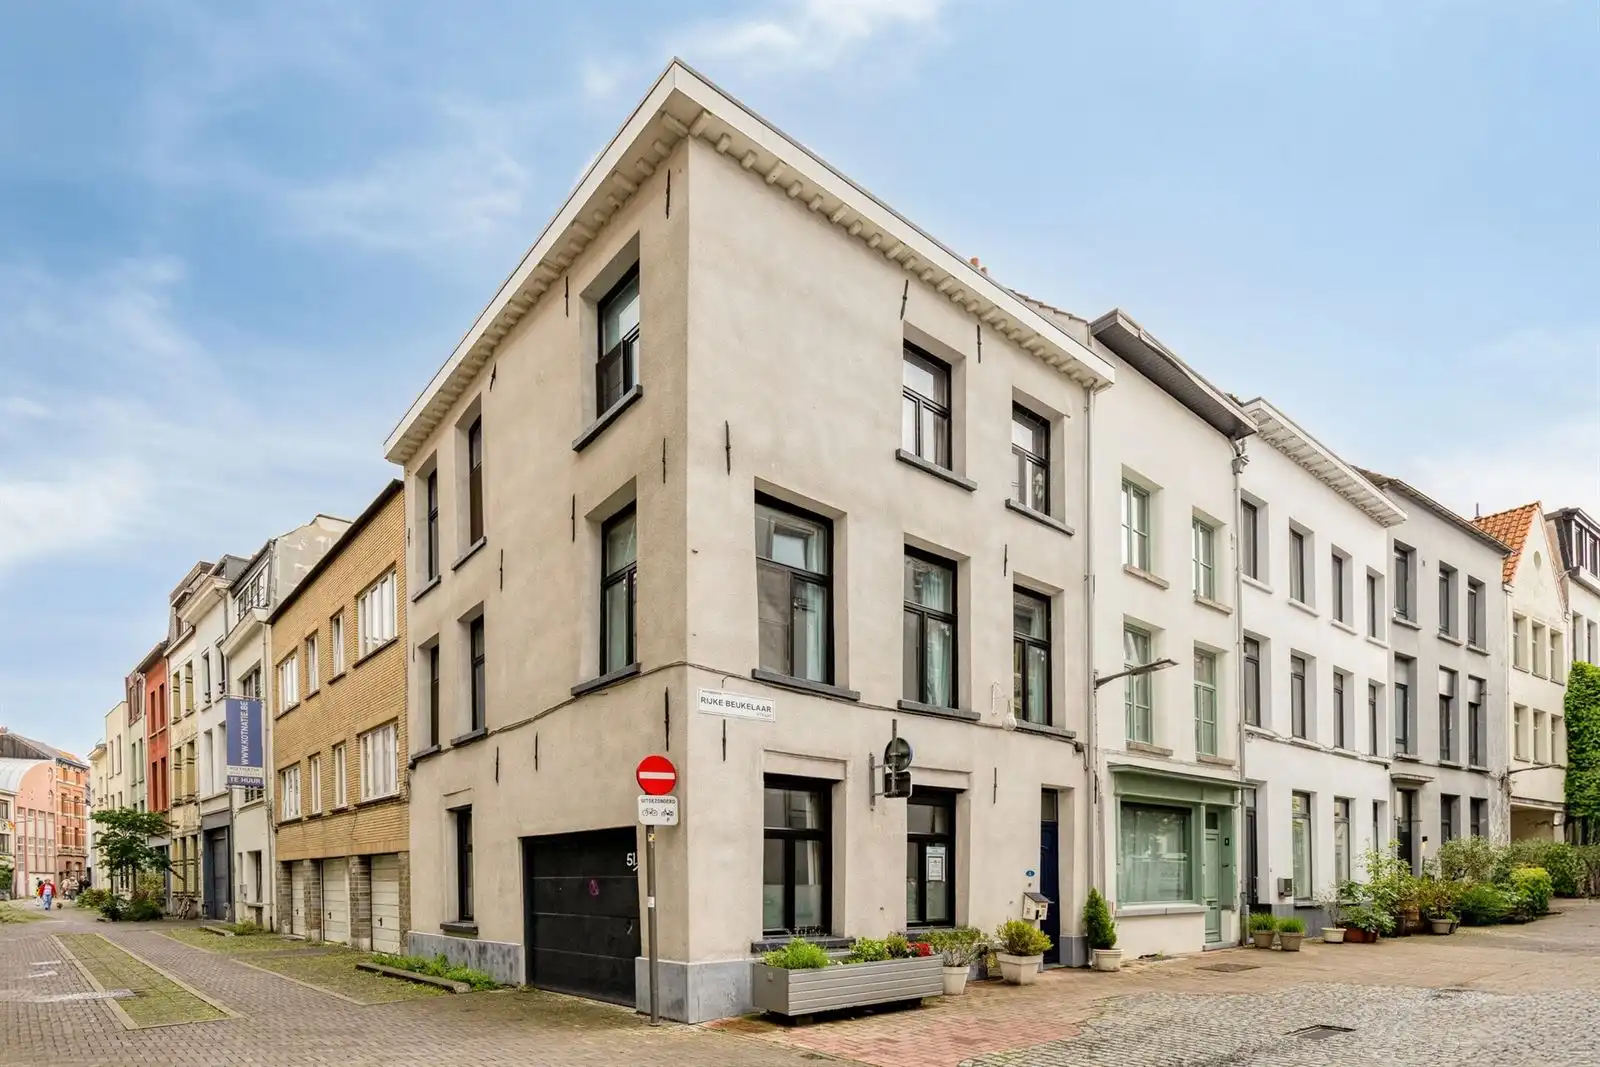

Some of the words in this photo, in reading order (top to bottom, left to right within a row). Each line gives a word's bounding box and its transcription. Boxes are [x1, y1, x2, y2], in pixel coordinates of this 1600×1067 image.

[700, 696, 723, 706] RIJKE
[726, 700, 772, 712] BEUKELAAR
[240, 700, 248, 765] WWW.KOTNATIE.BE
